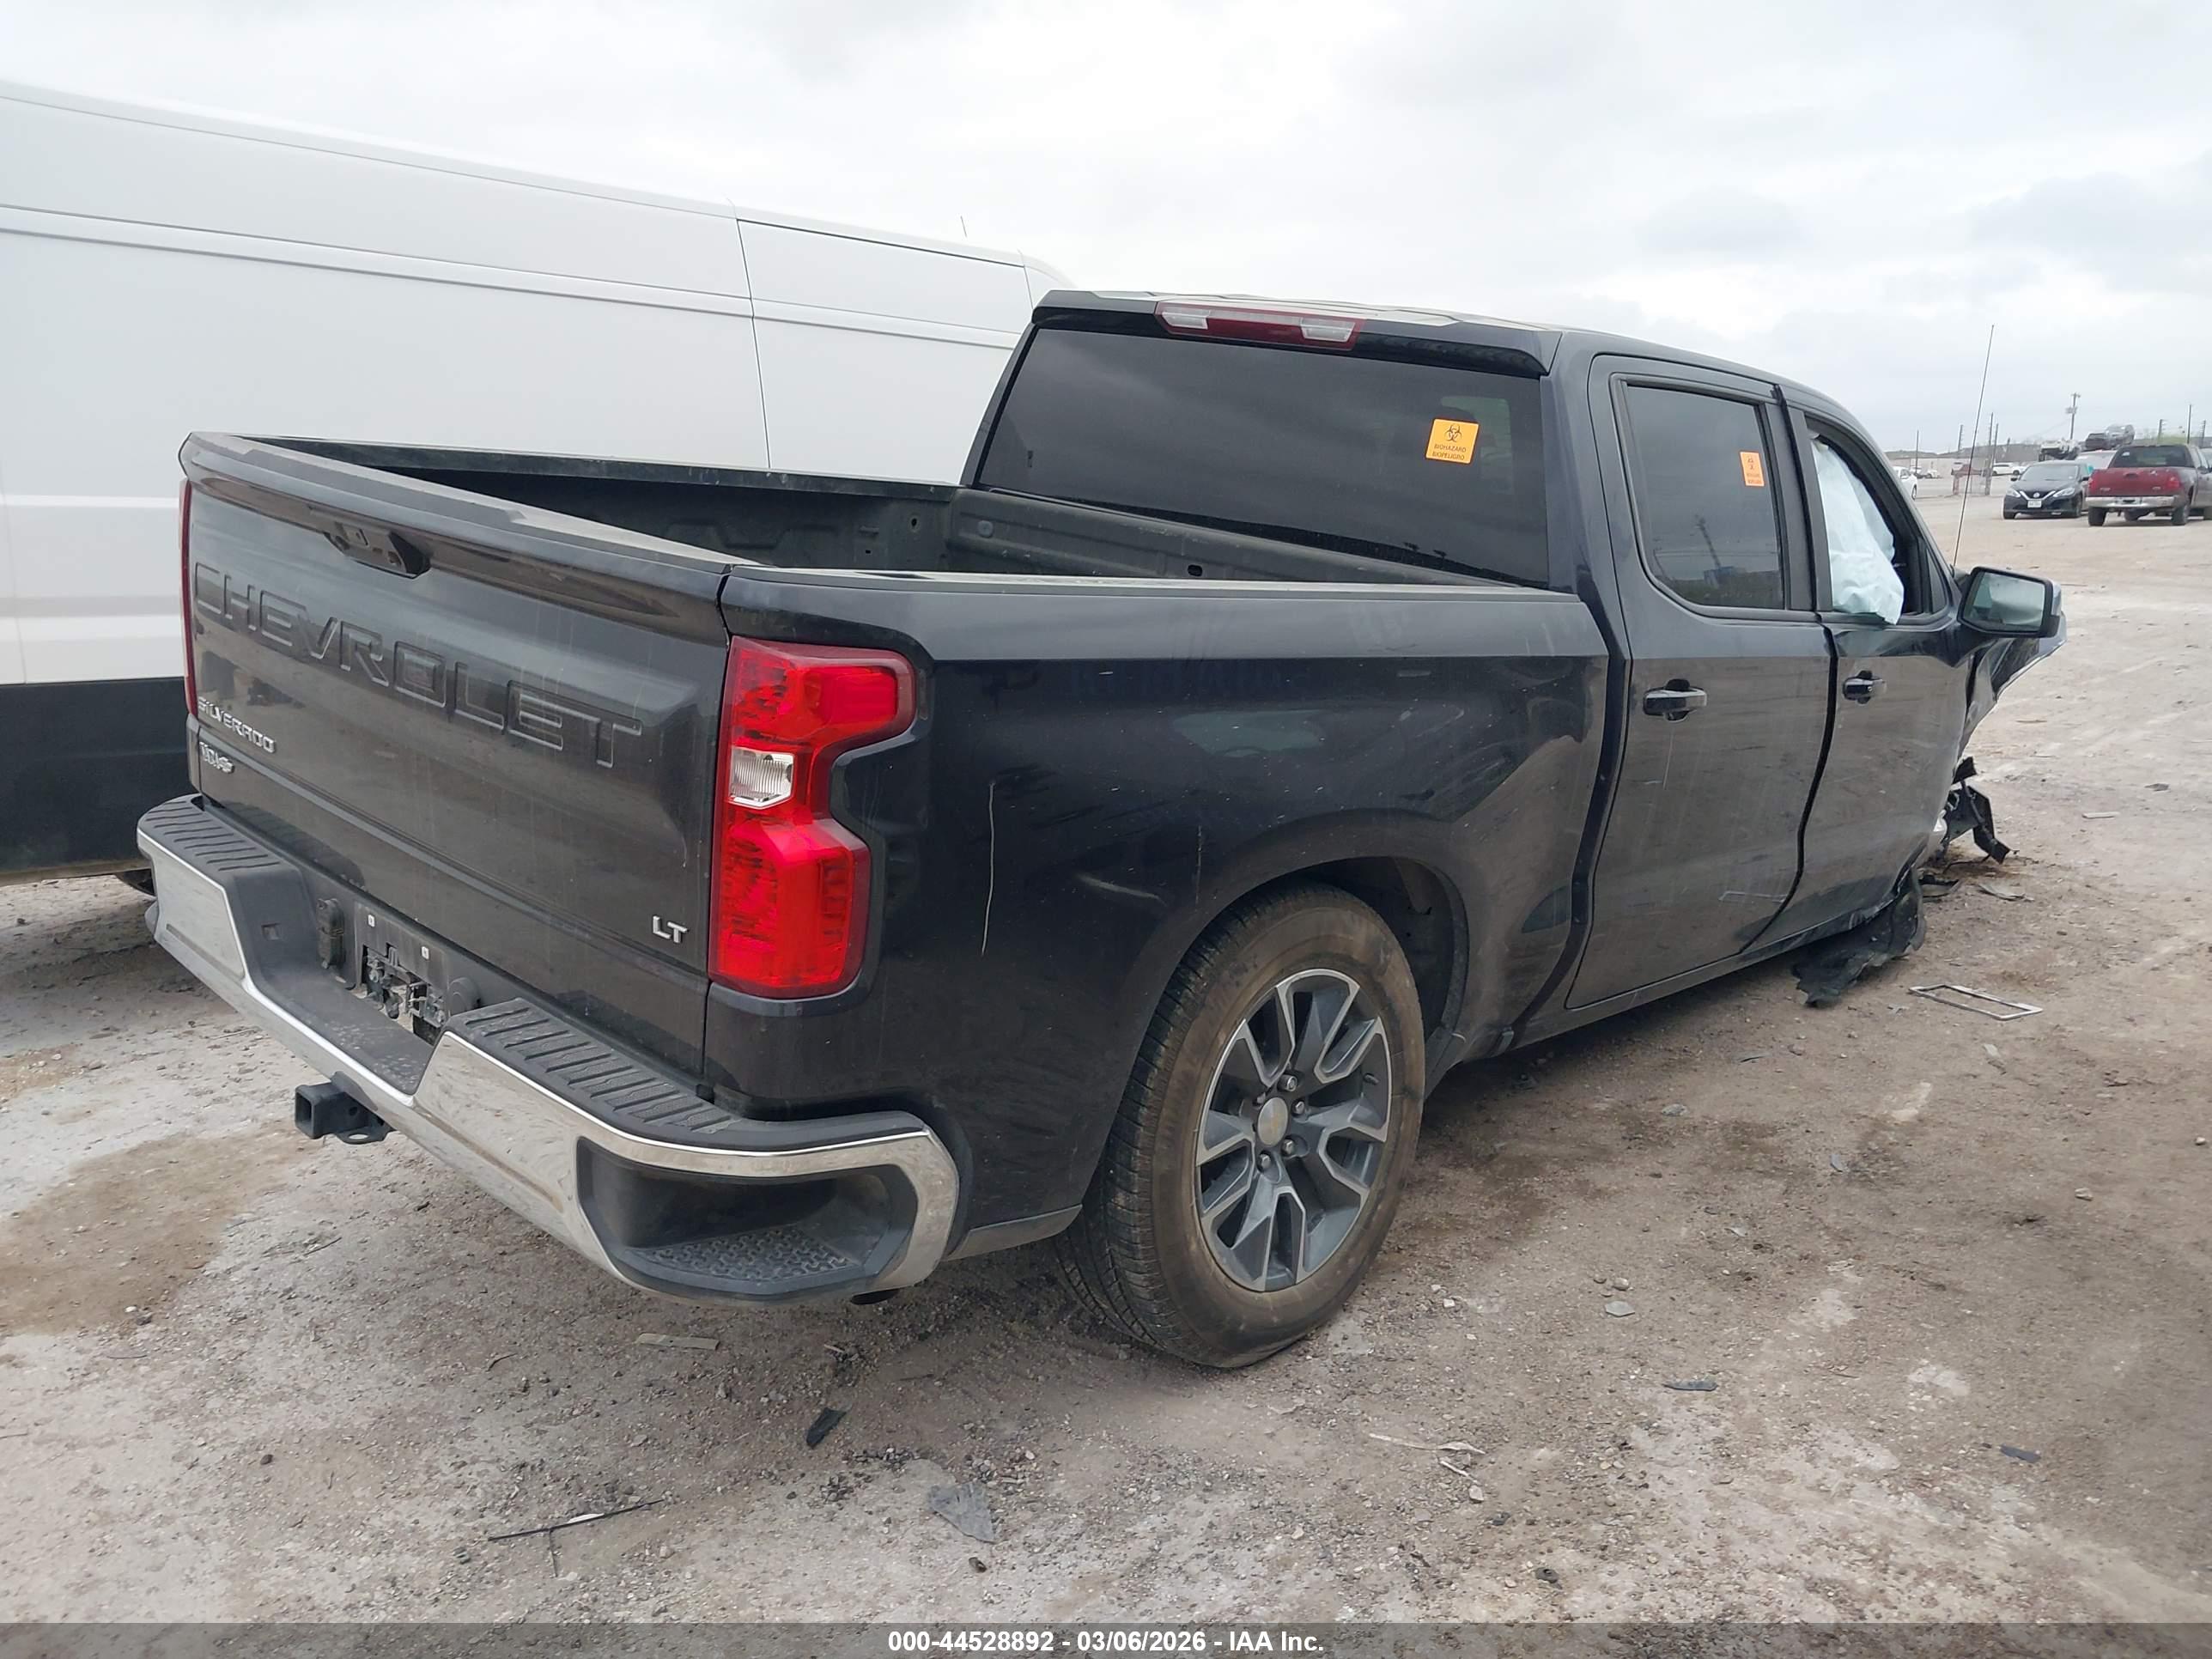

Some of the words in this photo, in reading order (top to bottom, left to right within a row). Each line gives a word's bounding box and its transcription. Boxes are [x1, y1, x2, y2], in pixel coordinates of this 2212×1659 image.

[195, 562, 642, 769] CHEVROLET
[198, 696, 276, 754] SILVERADO
[653, 915, 688, 944] LT
